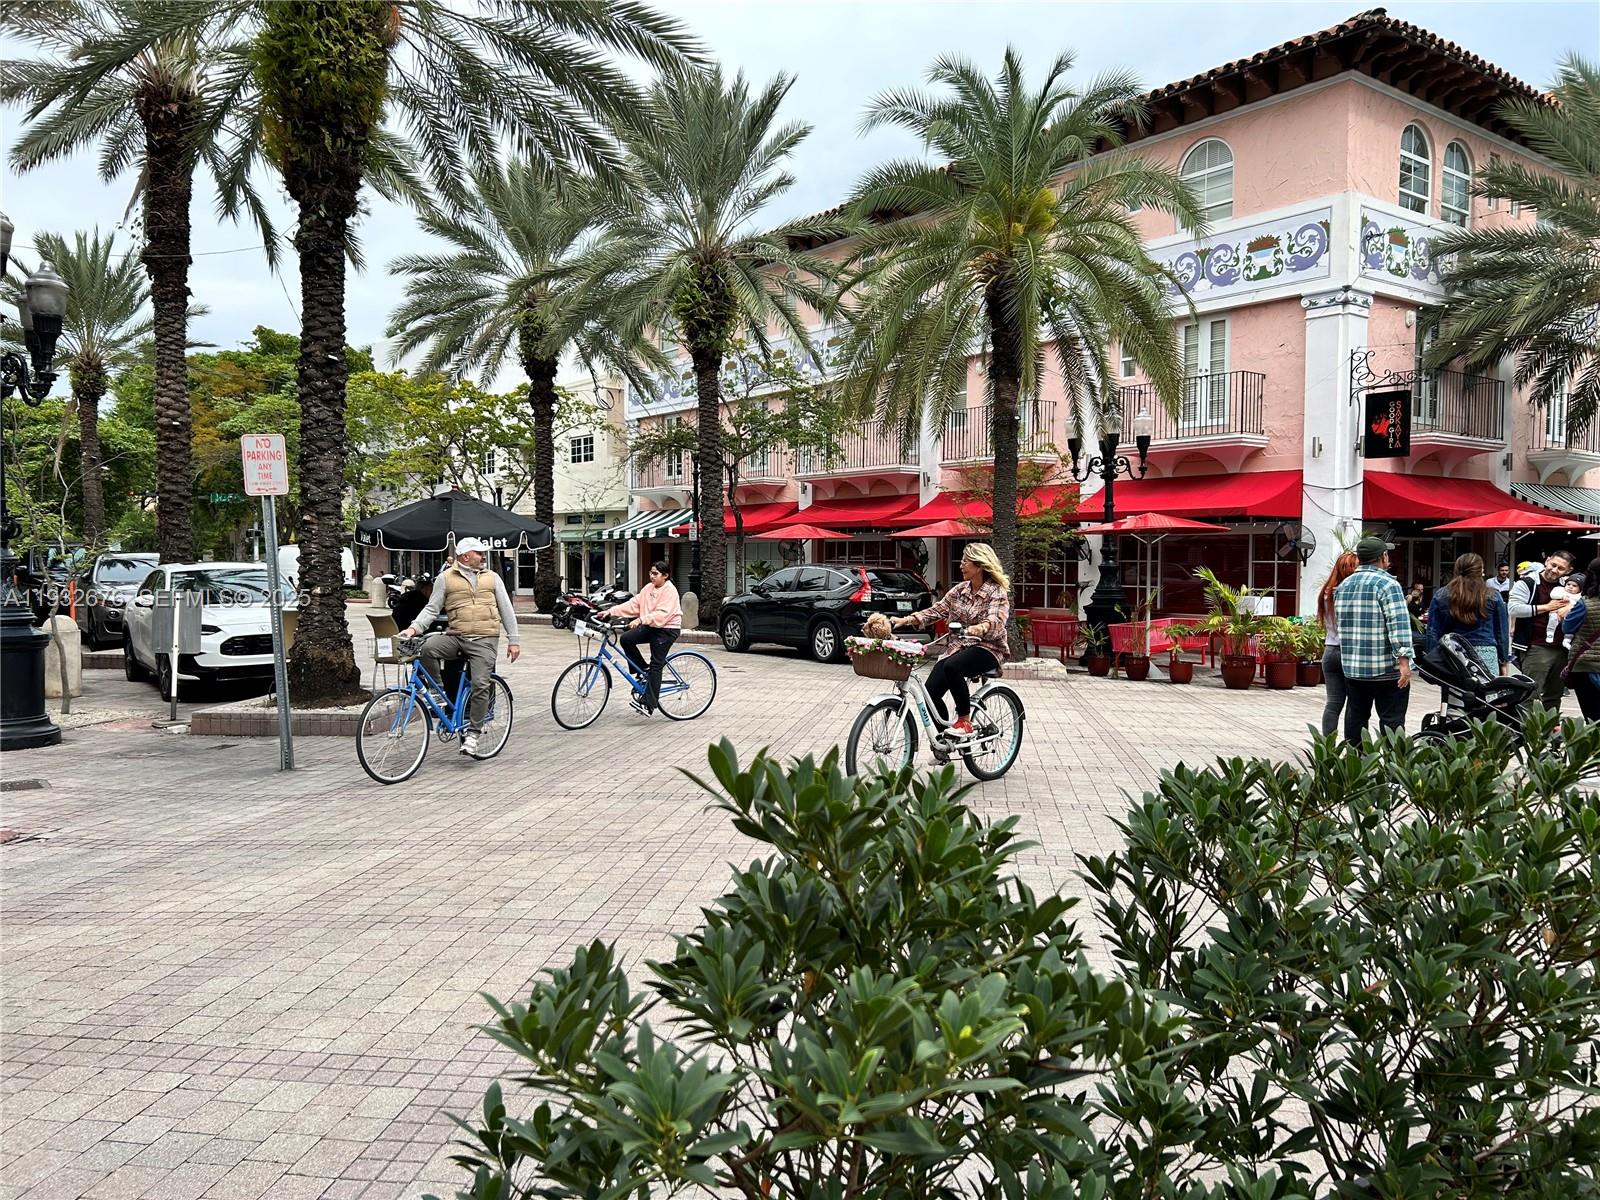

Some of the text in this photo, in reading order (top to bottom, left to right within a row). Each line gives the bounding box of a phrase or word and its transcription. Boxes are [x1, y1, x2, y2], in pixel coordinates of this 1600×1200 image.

[255, 438, 271, 448] NO
[246, 450, 282, 461] PARKING
[258, 463, 272, 471] ANY
[257, 472, 273, 480] TIME
